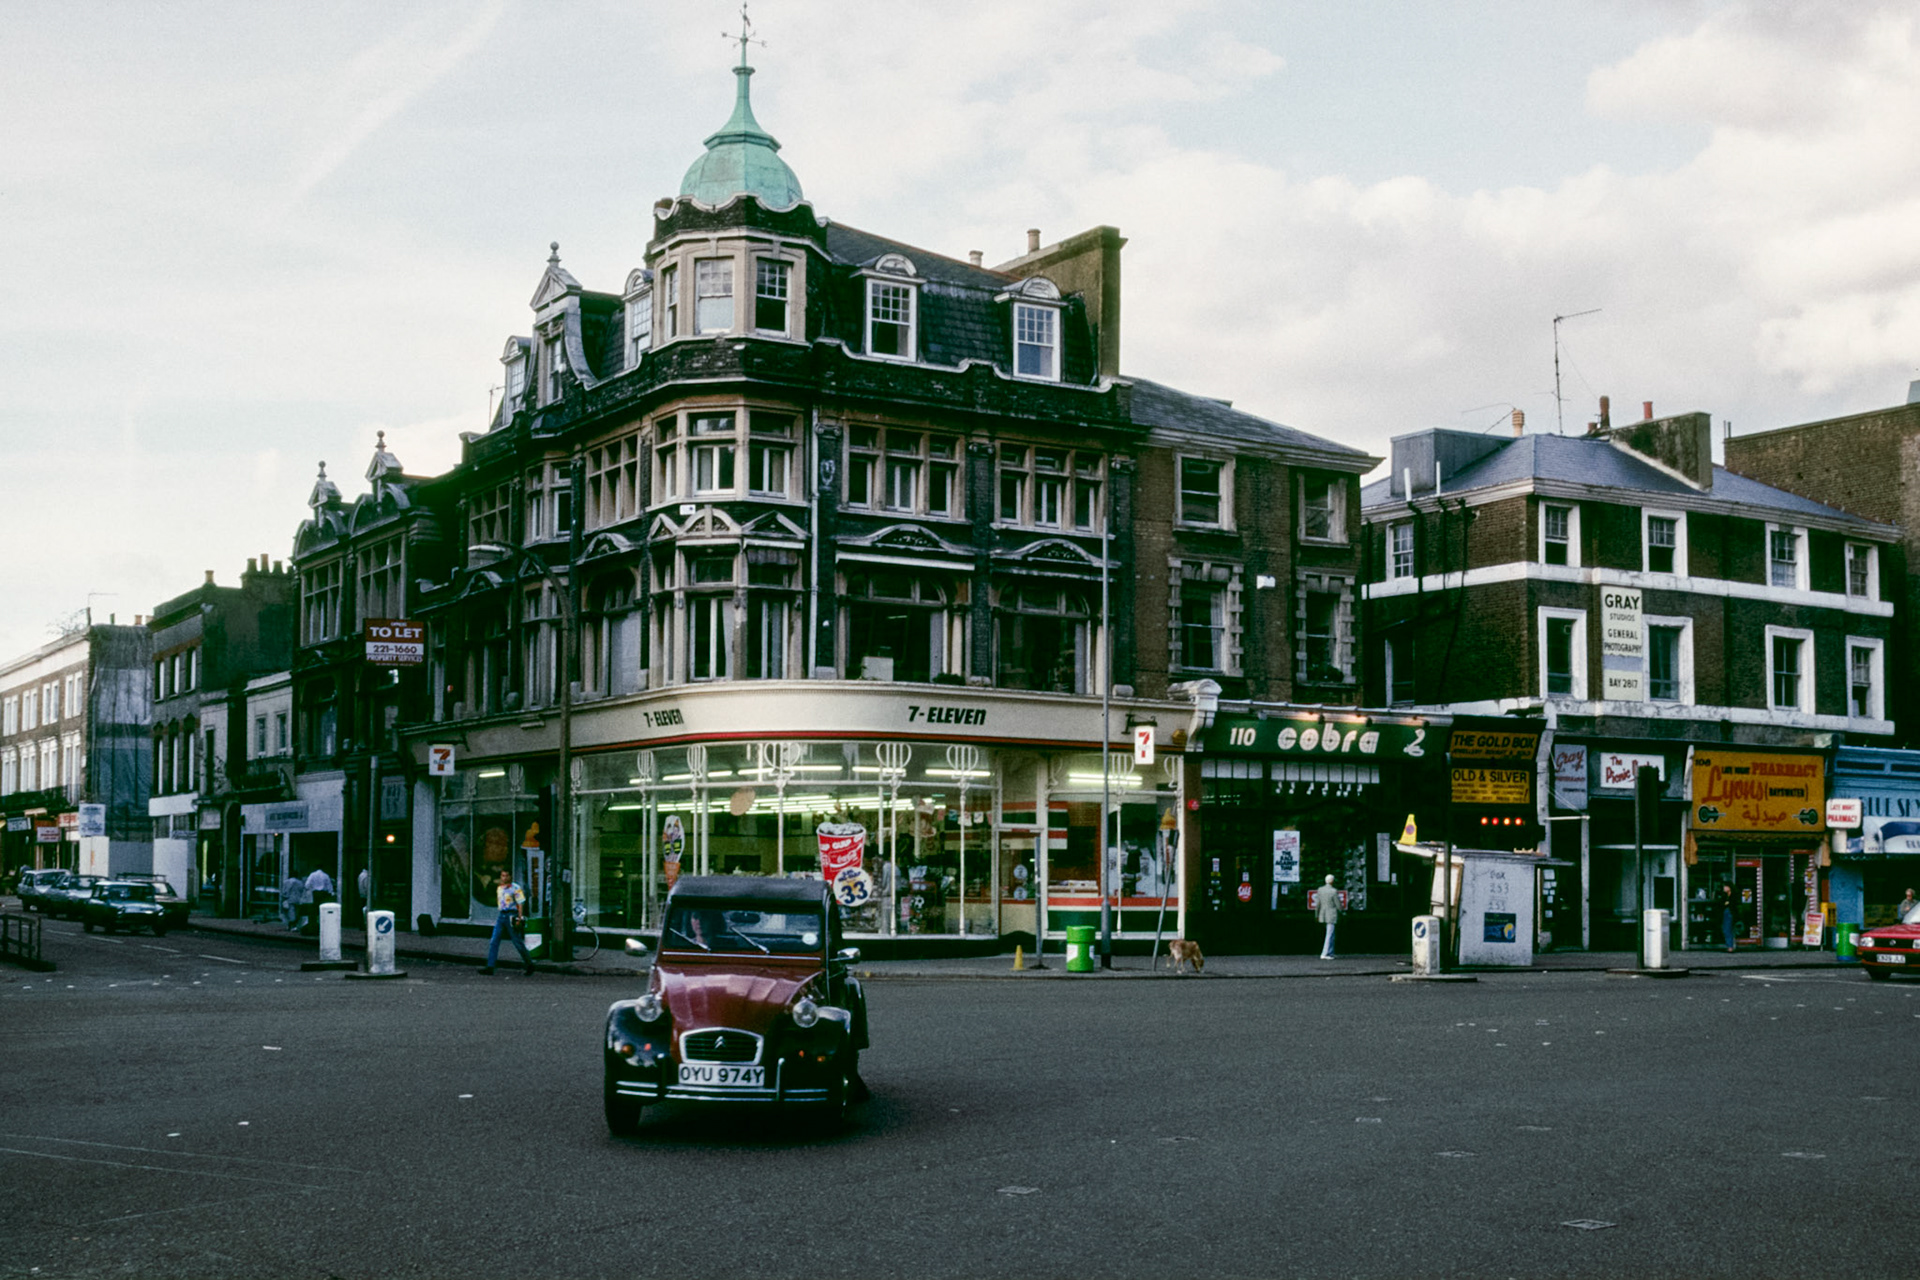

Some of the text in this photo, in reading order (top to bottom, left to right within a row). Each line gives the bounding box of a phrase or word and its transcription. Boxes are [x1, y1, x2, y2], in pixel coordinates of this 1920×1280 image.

[1604, 593, 1640, 610] GRAY
[1609, 612, 1635, 622] STUDIOS
[369, 626, 422, 638] TO LET
[1608, 628, 1638, 640] GENERAL
[373, 644, 417, 654] 221-1660
[1603, 642, 1642, 653] PHOTOGRAPHY
[1609, 677, 1638, 689] BAY 2817
[1138, 731, 1150, 758] 7
[1230, 722, 1380, 754] 110 cobra
[1453, 734, 1535, 749] THE GOLD BOX
[433, 748, 450, 771] 7
[1555, 749, 1585, 773] Gray
[1610, 755, 1623, 766] The
[1478, 770, 1486, 782] &
[1489, 771, 1527, 783] SILVER
[1605, 766, 1631, 783] Picnic
[1751, 762, 1818, 778] PHARMACY
[1701, 765, 1763, 808] Lyons
[1827, 814, 1858, 823] PHARMACY
[680, 1066, 764, 1083] OYU 974Y
